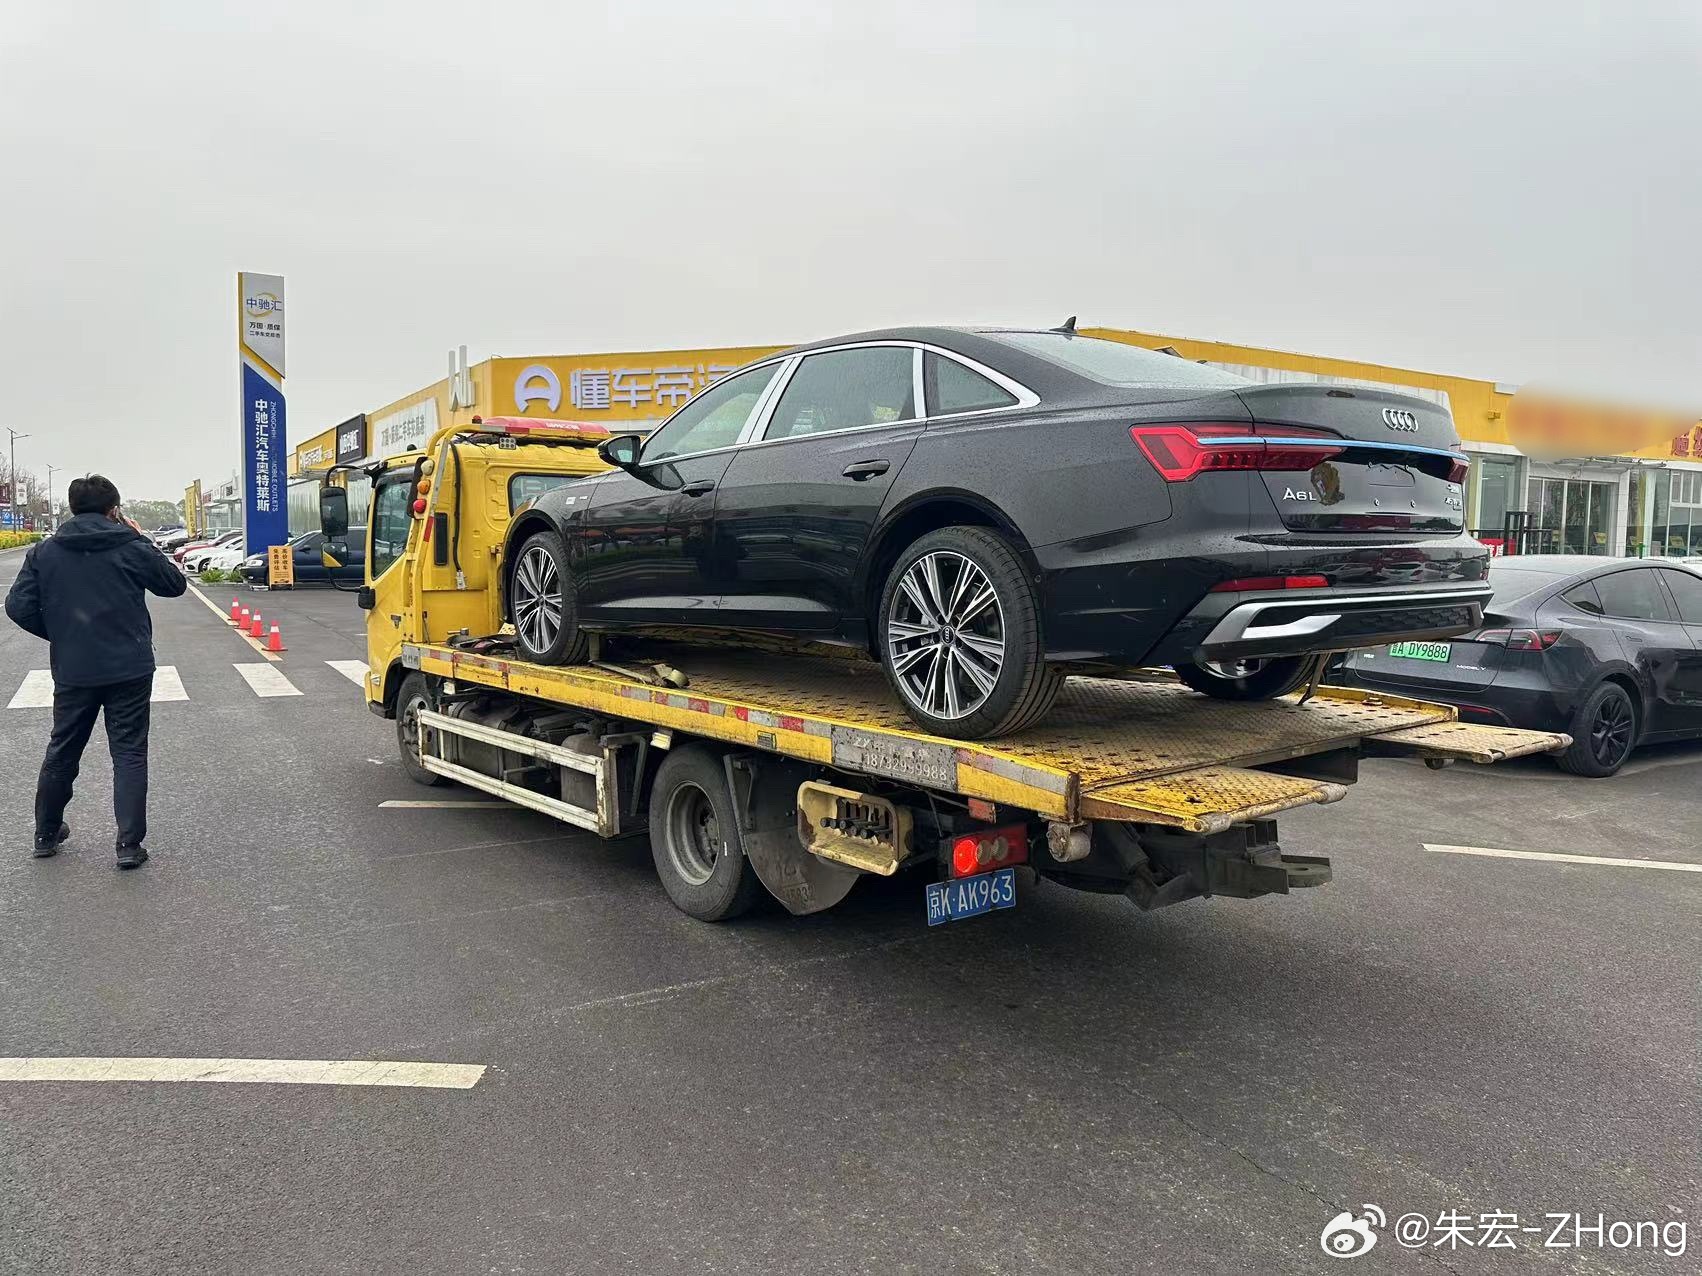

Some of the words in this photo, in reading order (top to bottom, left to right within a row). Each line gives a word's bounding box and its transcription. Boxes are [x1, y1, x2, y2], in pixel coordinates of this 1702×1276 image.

[247, 297, 282, 311] 中驰汇
[255, 399, 270, 512] 中驰汇汽车奥特莱斯
[1283, 487, 1317, 501] A6L
[1408, 643, 1448, 659] DY9888
